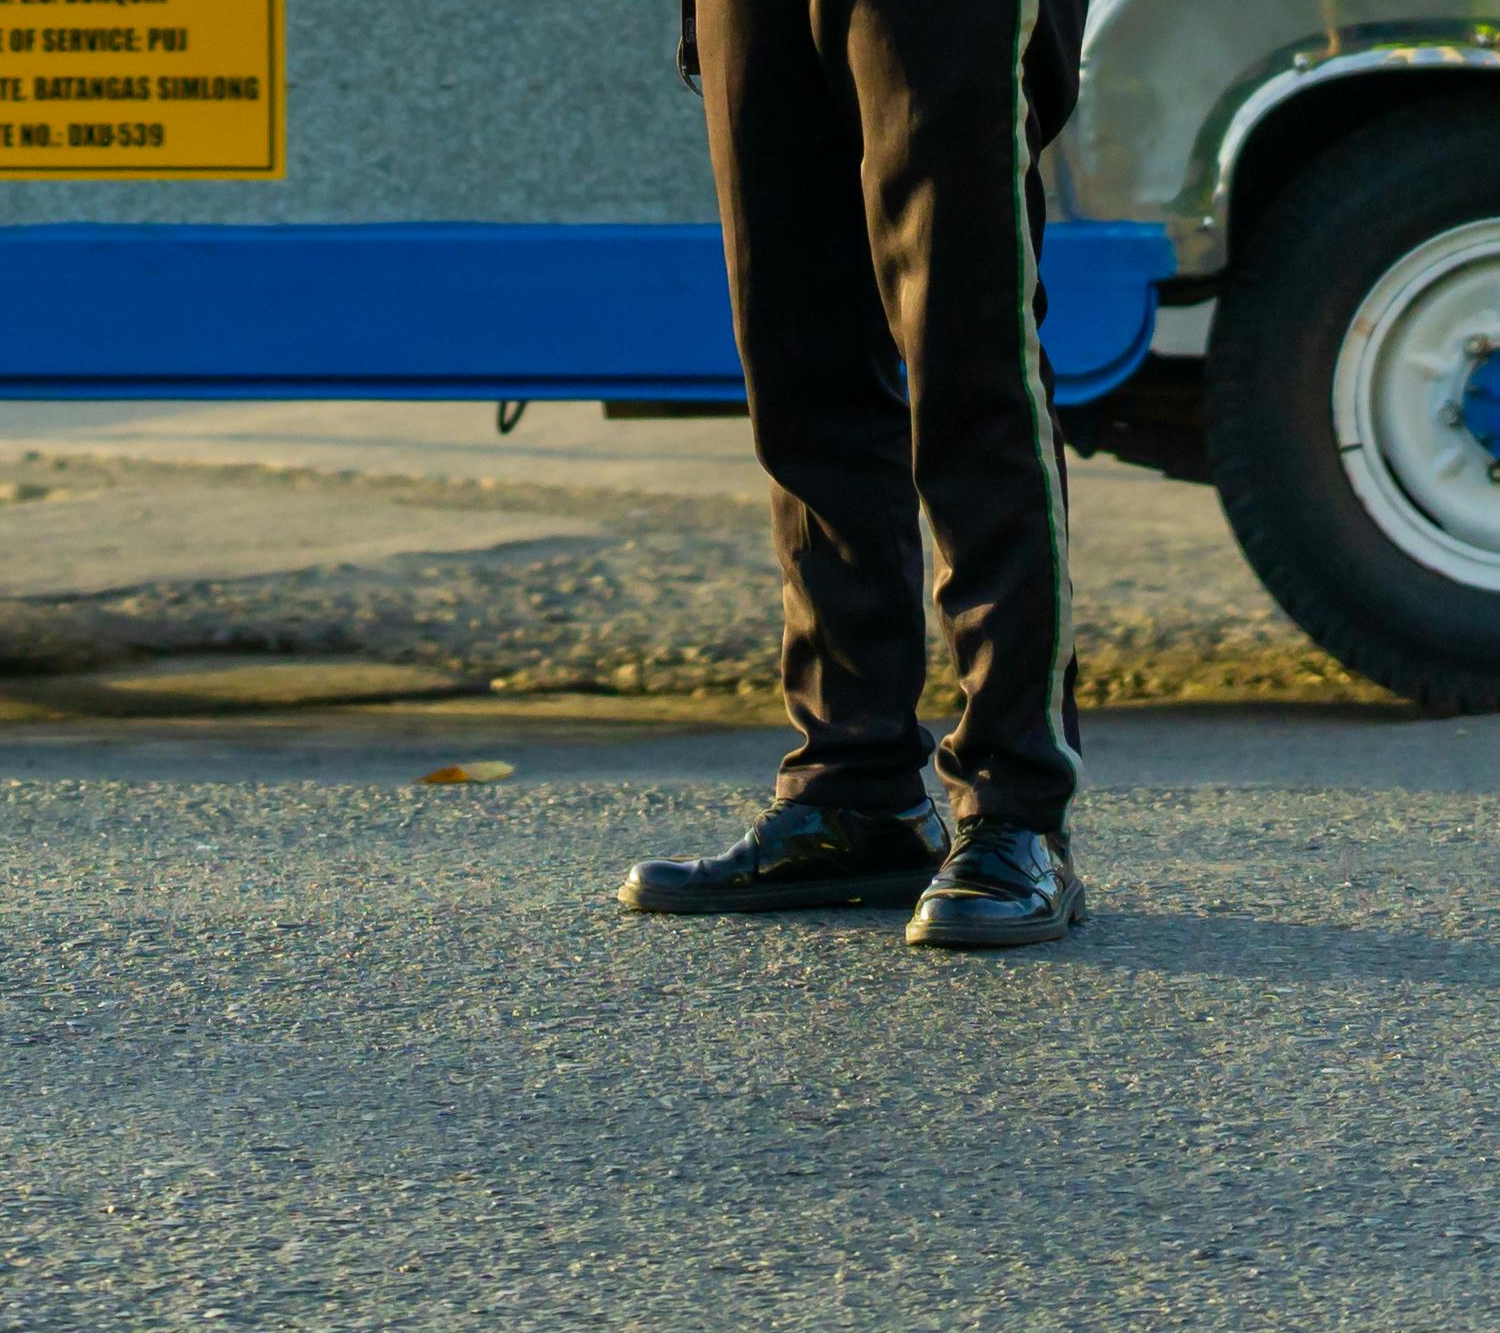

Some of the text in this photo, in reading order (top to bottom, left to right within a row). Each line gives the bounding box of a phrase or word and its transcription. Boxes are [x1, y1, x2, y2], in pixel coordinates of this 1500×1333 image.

[10, 28, 36, 52] OF
[148, 28, 188, 52] PUJ
[33, 76, 151, 101] BATANGAS
[157, 76, 260, 101] SIMLONG
